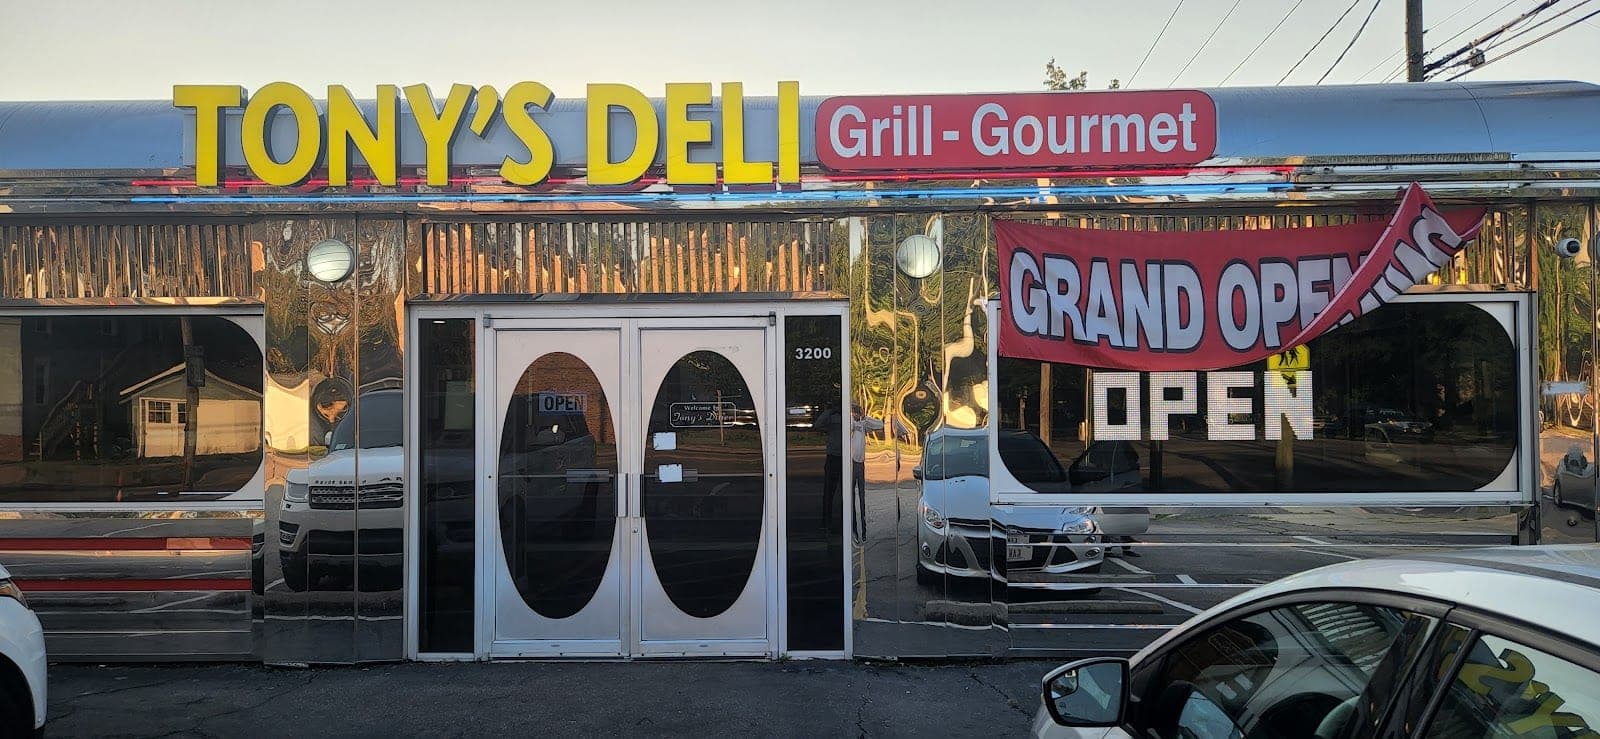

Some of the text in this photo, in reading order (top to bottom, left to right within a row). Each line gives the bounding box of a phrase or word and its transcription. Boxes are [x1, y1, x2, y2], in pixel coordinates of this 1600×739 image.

[173, 81, 799, 187] TONY'S DELI
[830, 104, 932, 158] Grill
[972, 102, 1197, 157] Gourmet
[1009, 248, 1204, 353] GRAND
[795, 347, 832, 360] 3200
[544, 396, 584, 411] OPEN
[683, 404, 711, 412] Welcome
[1093, 371, 1314, 441] OPEN
